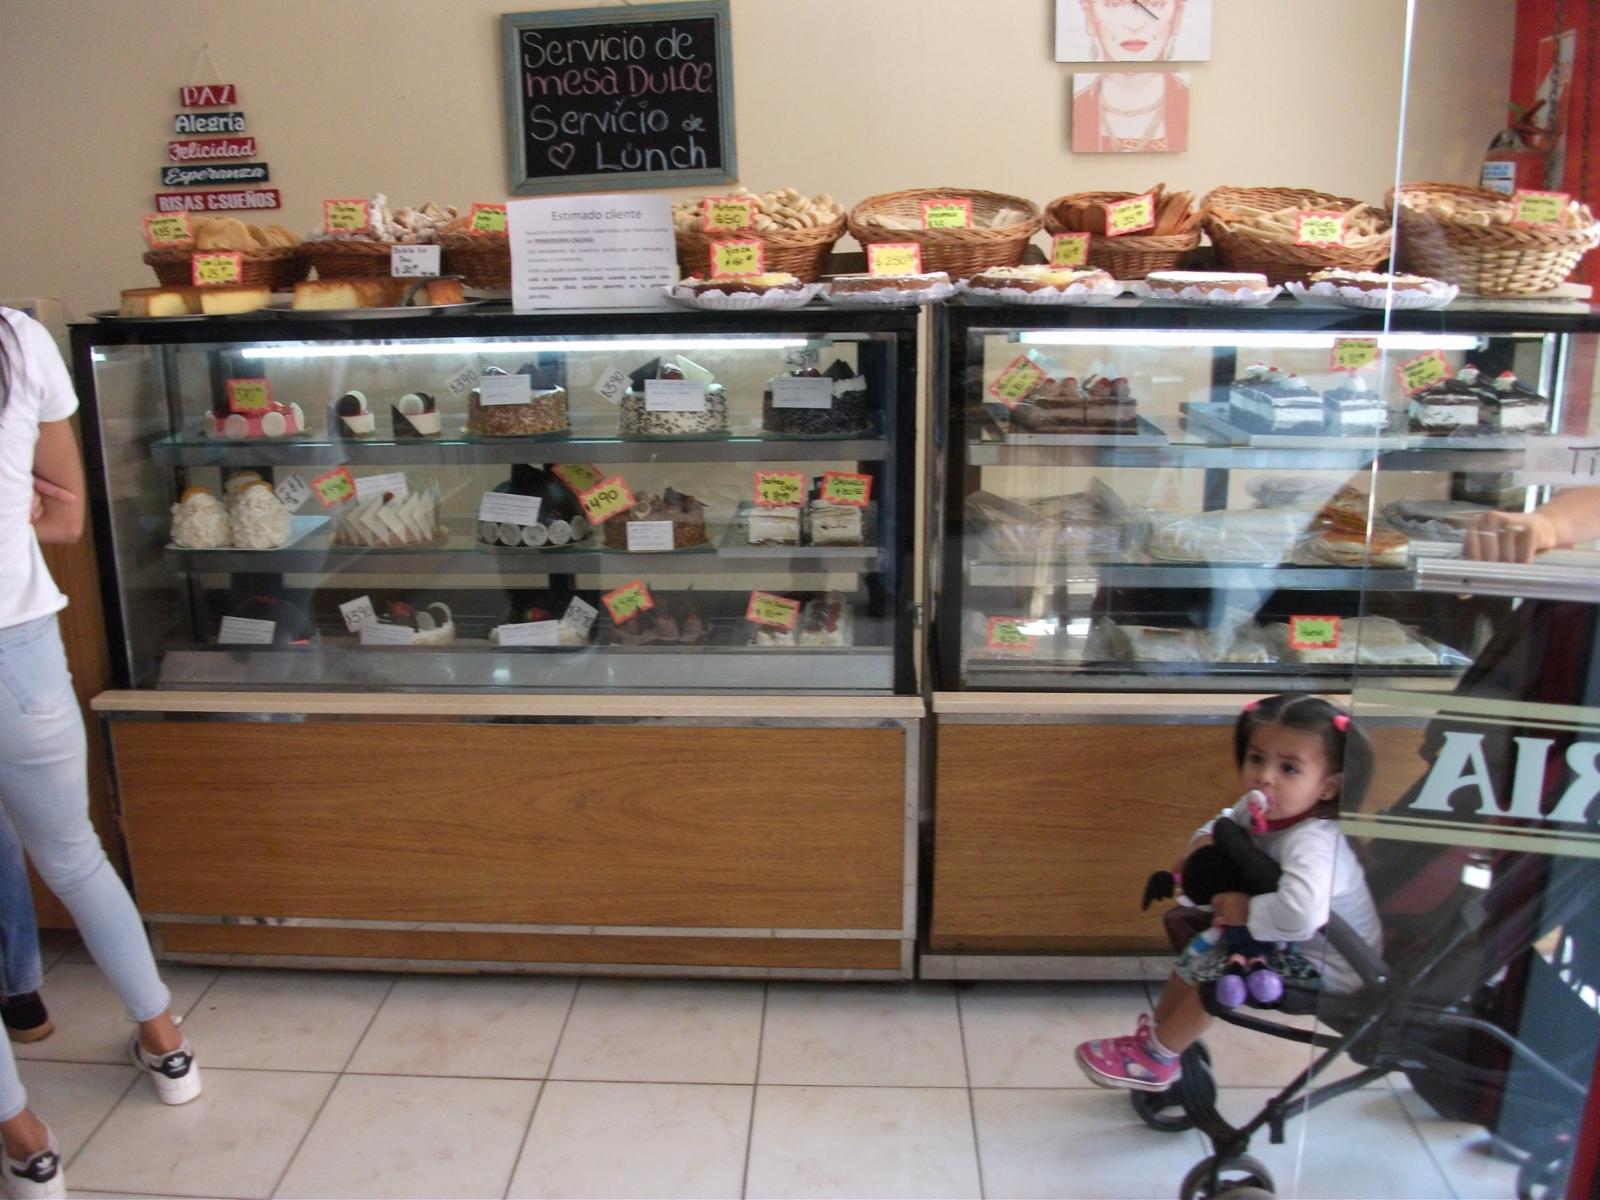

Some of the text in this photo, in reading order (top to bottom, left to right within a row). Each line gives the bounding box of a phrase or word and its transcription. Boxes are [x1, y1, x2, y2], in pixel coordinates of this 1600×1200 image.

[522, 27, 696, 69] Servicio de
[526, 67, 620, 98] mesa
[184, 85, 231, 105] PAZ
[174, 113, 245, 132] Alegría
[530, 103, 706, 141] Servicio de
[169, 139, 256, 161] Felicidad
[597, 135, 707, 171] Lunch
[164, 166, 266, 185] Esperanza
[158, 195, 205, 211] RISAS
[552, 209, 642, 221] Estimado cliente
